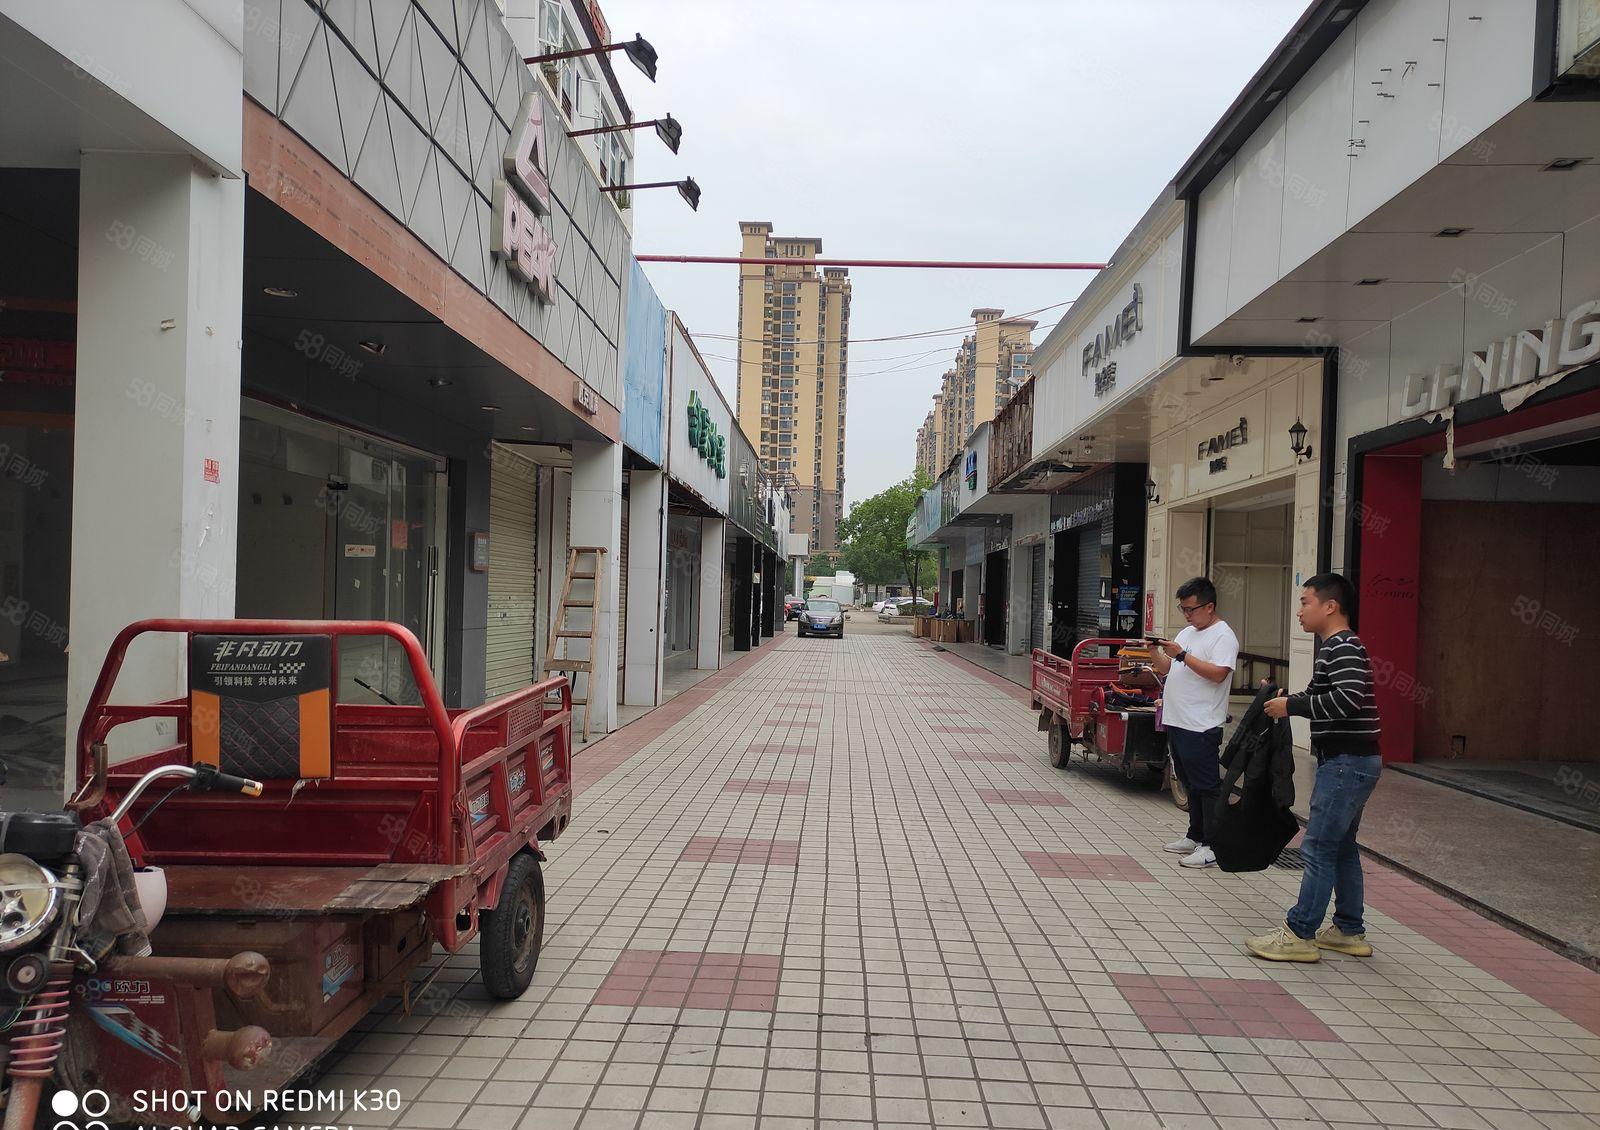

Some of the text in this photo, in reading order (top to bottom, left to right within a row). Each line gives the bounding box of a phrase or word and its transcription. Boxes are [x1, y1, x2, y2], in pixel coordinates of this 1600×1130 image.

[492, 178, 558, 306] PEAK
[213, 641, 303, 662] 非凡动力
[214, 676, 297, 686] 引领科技 共创未来
